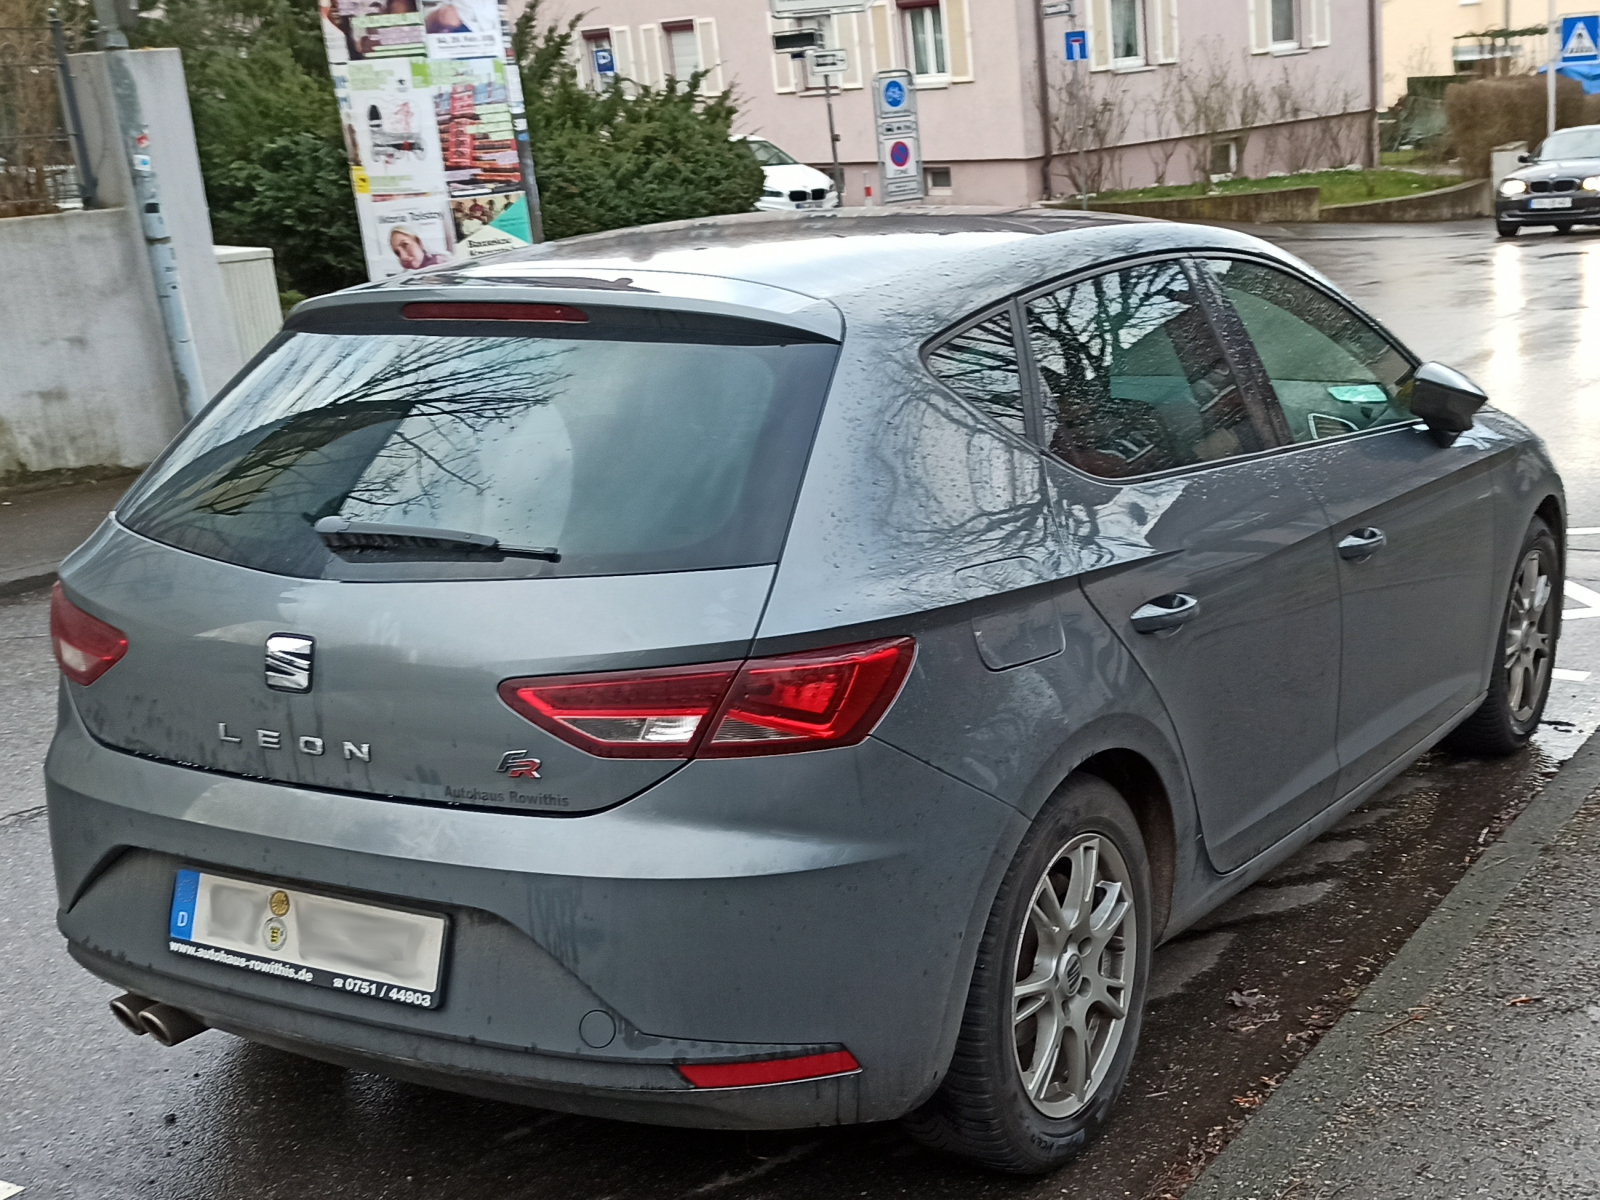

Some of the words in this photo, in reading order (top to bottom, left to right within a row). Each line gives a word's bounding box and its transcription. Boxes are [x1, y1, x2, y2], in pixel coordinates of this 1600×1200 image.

[218, 722, 371, 762] LEON
[495, 749, 542, 779] FR
[444, 785, 505, 801] Autohaus
[508, 790, 570, 807] Rowithis
[176, 911, 188, 927] D
[169, 941, 314, 982] www.autohaus-rowithis.de
[344, 977, 377, 996] 0751
[388, 987, 431, 1007] 44903
